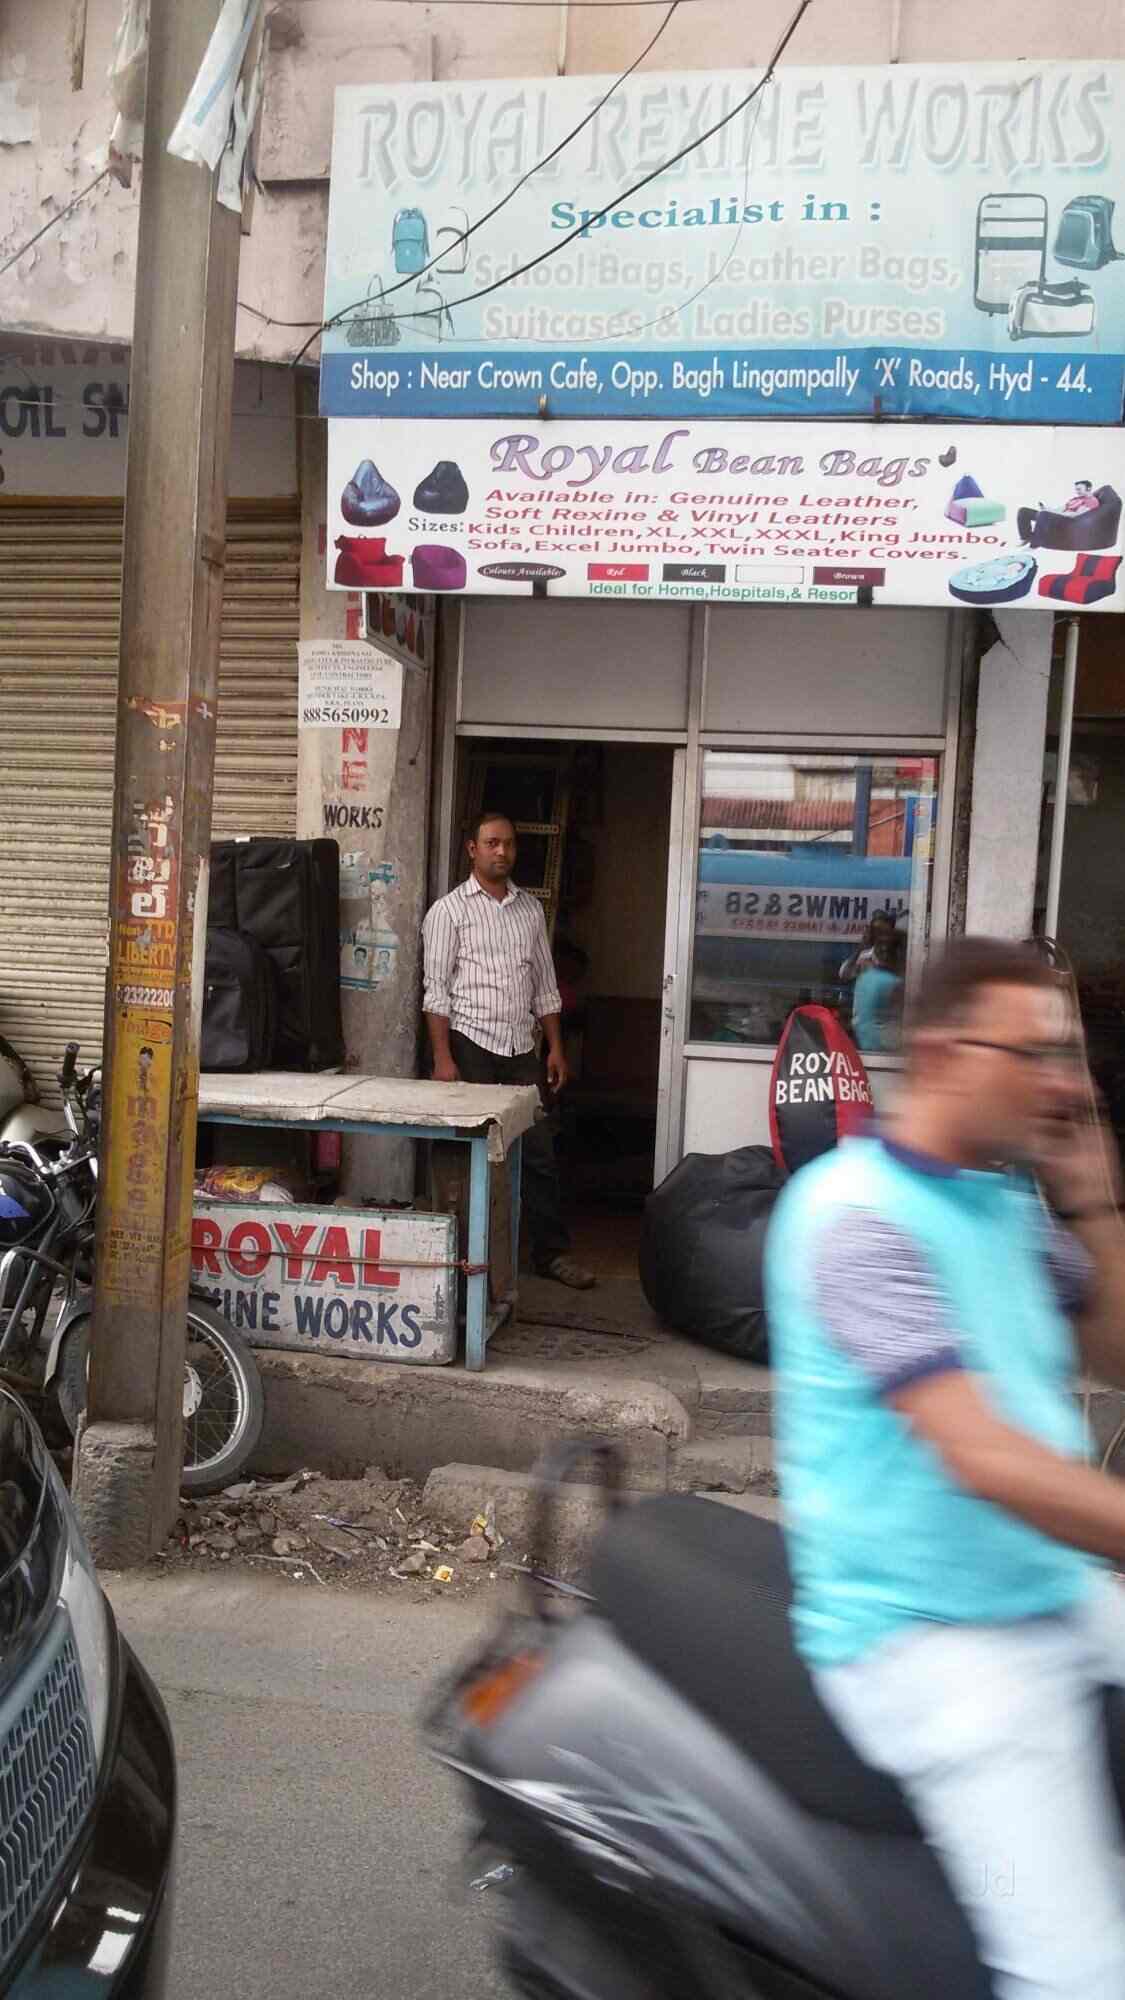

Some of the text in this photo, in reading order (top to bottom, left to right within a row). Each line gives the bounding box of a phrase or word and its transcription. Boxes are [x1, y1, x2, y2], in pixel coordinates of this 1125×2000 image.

[358, 73, 1113, 190] ROYAL REXINE WORKS
[551, 197, 784, 238] Specialist
[801, 194, 849, 222] in
[474, 247, 960, 294] School Bags, Leather Bags,
[486, 300, 941, 338] Suitcases & Ladies Purses
[350, 359, 400, 397] Shop
[420, 362, 471, 389] Near
[478, 361, 542, 389] Crown
[551, 358, 604, 394] Cafe,
[611, 361, 663, 397] Opp.
[673, 357, 724, 397] Bagh
[733, 355, 859, 397] Lingampally
[909, 357, 980, 395] Roads,
[990, 360, 1033, 400] Hyd
[1056, 363, 1093, 393] 44.
[490, 430, 931, 488] Royal Bean Bags
[486, 489, 918, 511] Available in: Genuine Leather,
[484, 506, 897, 527] Soft Rexine & Vinyl Leathers
[408, 517, 464, 533] Sizes:
[468, 523, 520, 536] Kids
[908, 531, 1008, 548] Jumbo,
[774, 544, 863, 560] Seater
[868, 547, 968, 562] Covers.
[589, 583, 626, 595] Ideal
[632, 583, 652, 596] for
[807, 588, 857, 601] Resor
[303, 706, 390, 725] 8885650992
[323, 804, 384, 829] WORKS
[789, 1051, 860, 1077] ROYAL
[775, 1077, 835, 1105] BEAN
[192, 1218, 401, 1290] ROYAL
[295, 1295, 422, 1348] WORKS
